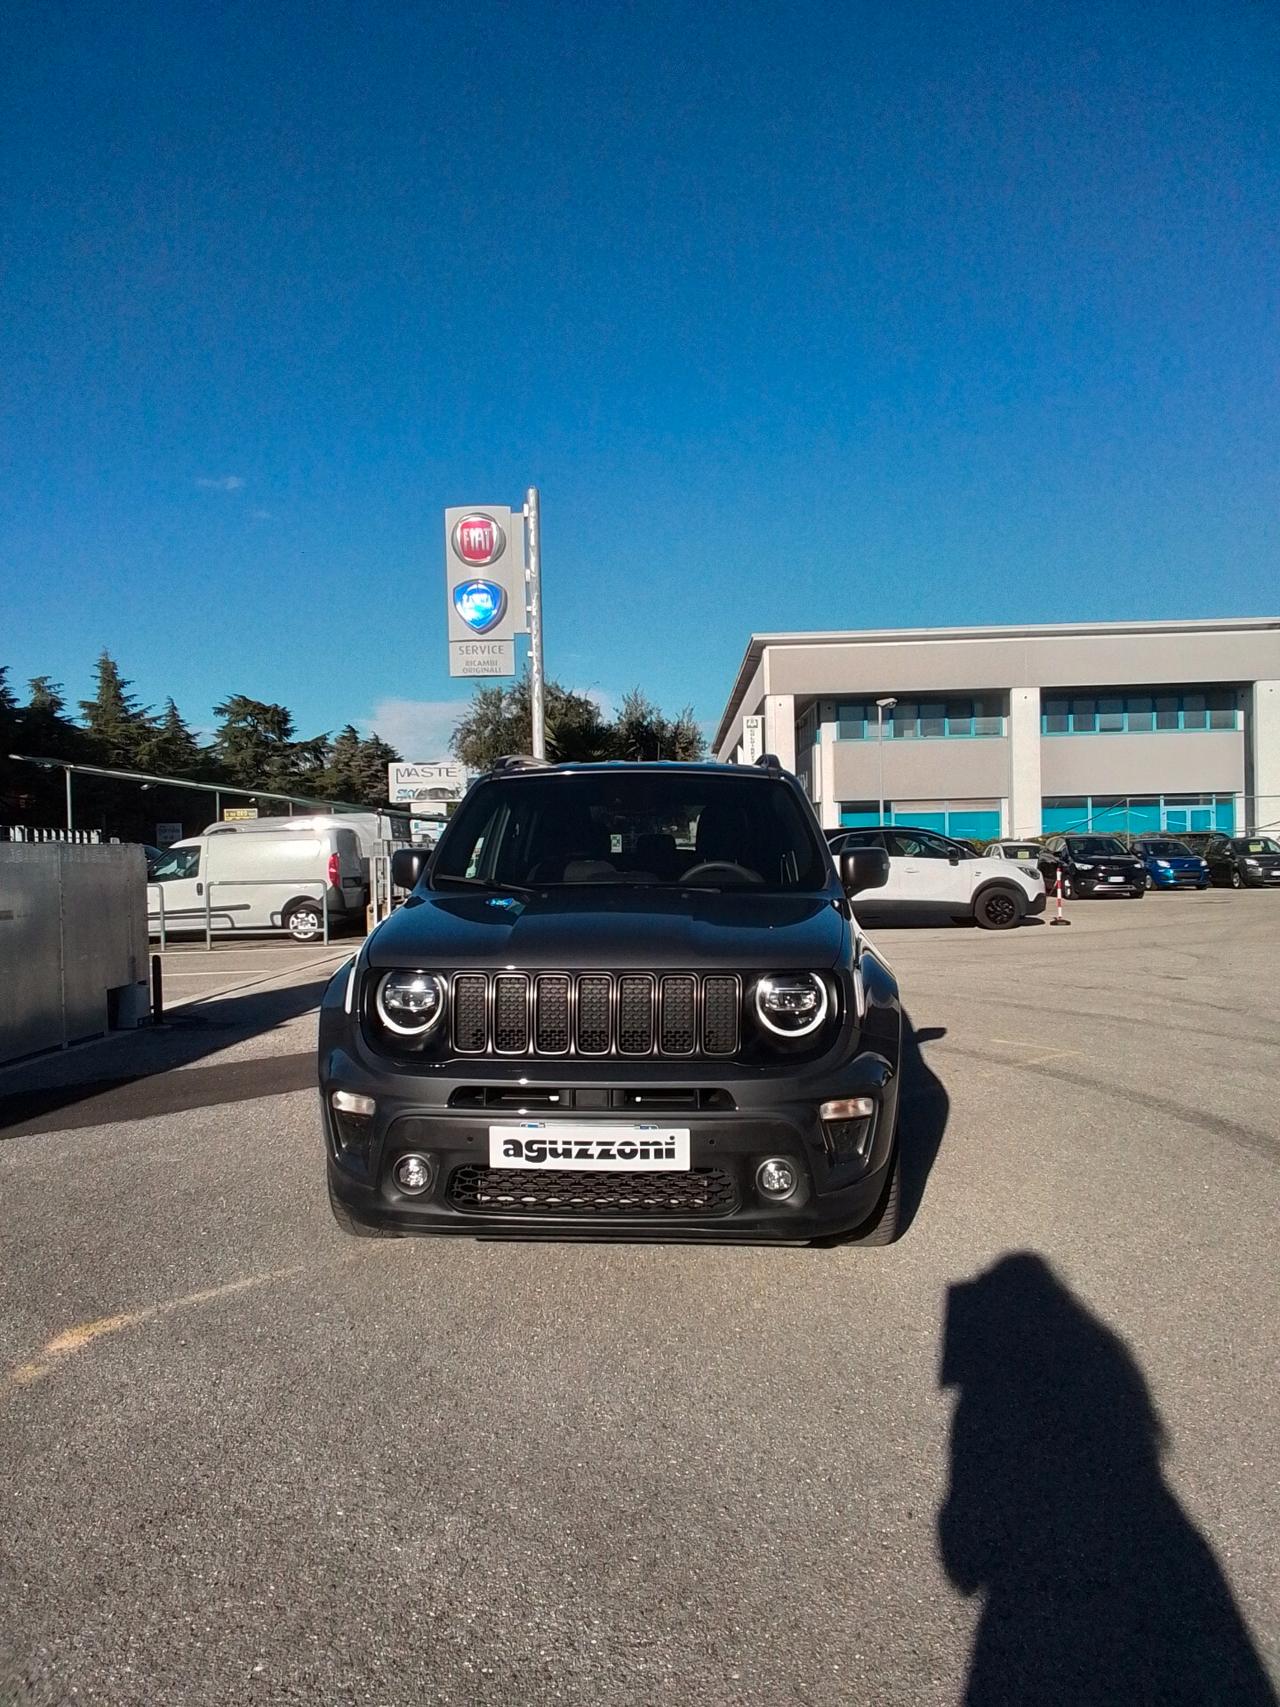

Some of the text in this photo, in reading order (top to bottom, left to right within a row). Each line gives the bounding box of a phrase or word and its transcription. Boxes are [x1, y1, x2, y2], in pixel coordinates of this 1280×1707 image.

[463, 527, 492, 551] FIAT
[458, 645, 505, 656] SERVICE
[503, 1135, 676, 1163] aguzzoni
